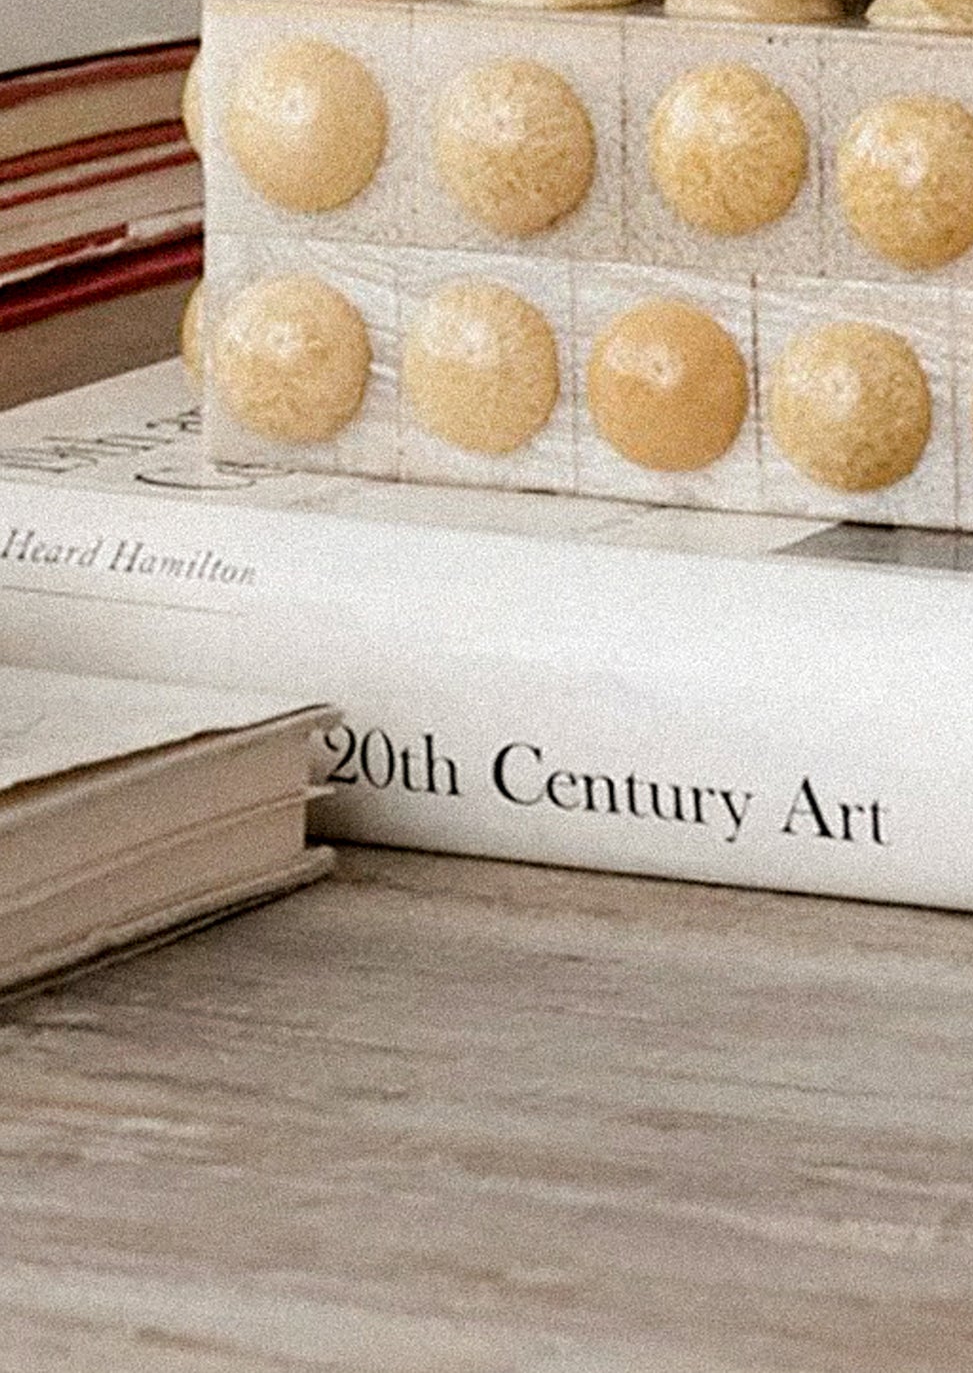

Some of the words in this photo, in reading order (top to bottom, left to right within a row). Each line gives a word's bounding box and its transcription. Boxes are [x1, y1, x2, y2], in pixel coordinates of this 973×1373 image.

[1, 528, 104, 567] Heard
[107, 539, 256, 584] Hamilton
[324, 727, 461, 796] 20th
[492, 742, 753, 842] Century
[780, 776, 892, 846] Art
